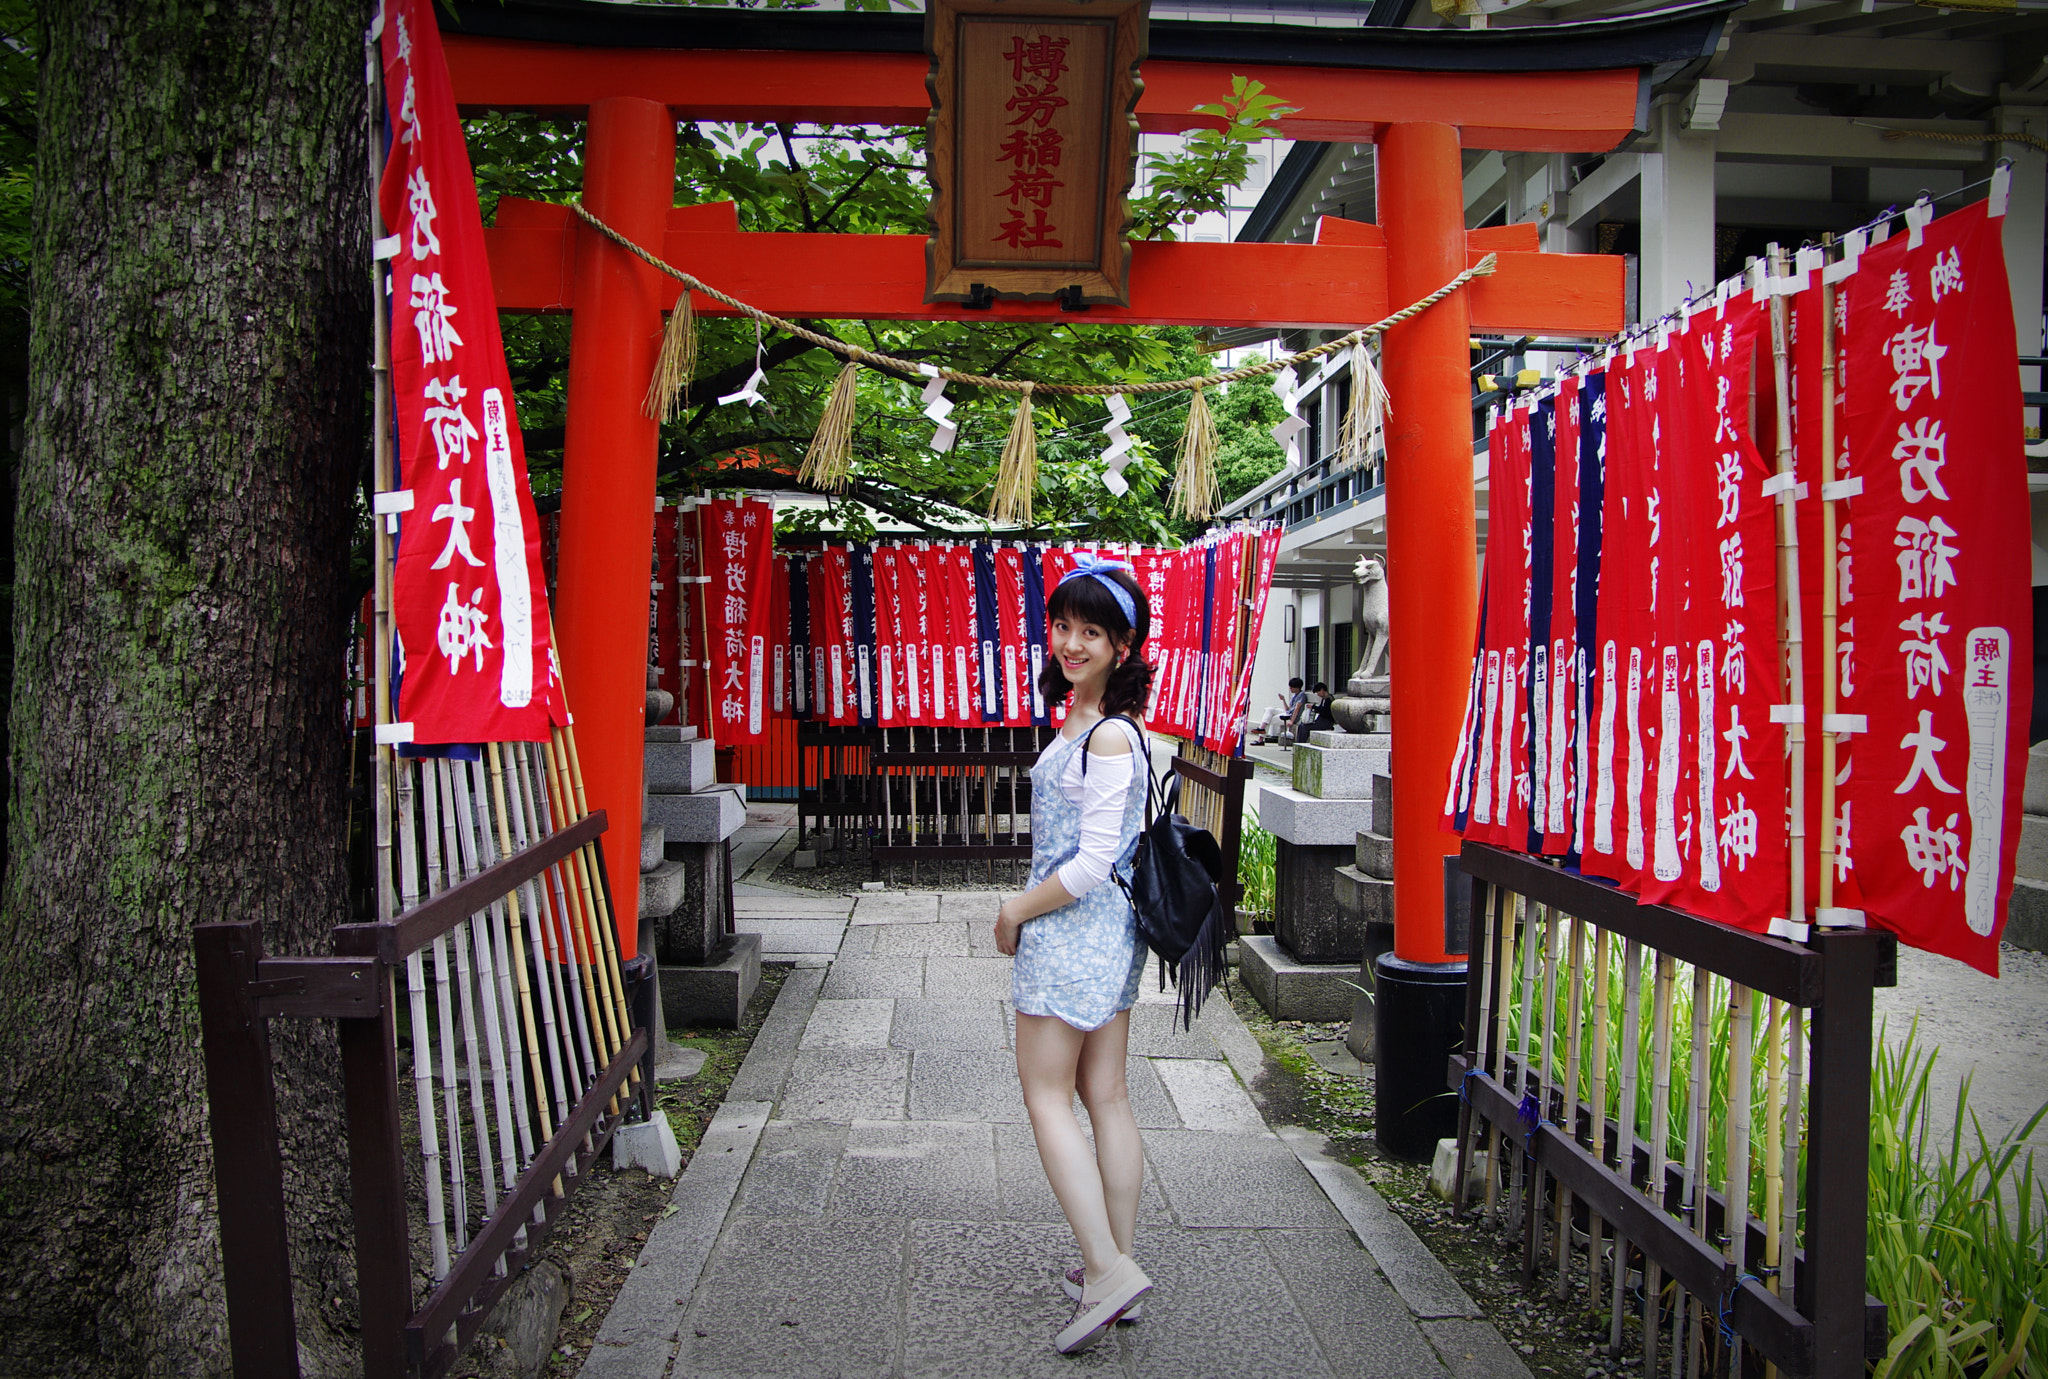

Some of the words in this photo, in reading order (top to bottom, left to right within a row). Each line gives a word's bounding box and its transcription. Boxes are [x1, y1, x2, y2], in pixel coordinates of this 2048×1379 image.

[992, 35, 1070, 249] 博労稲荷社
